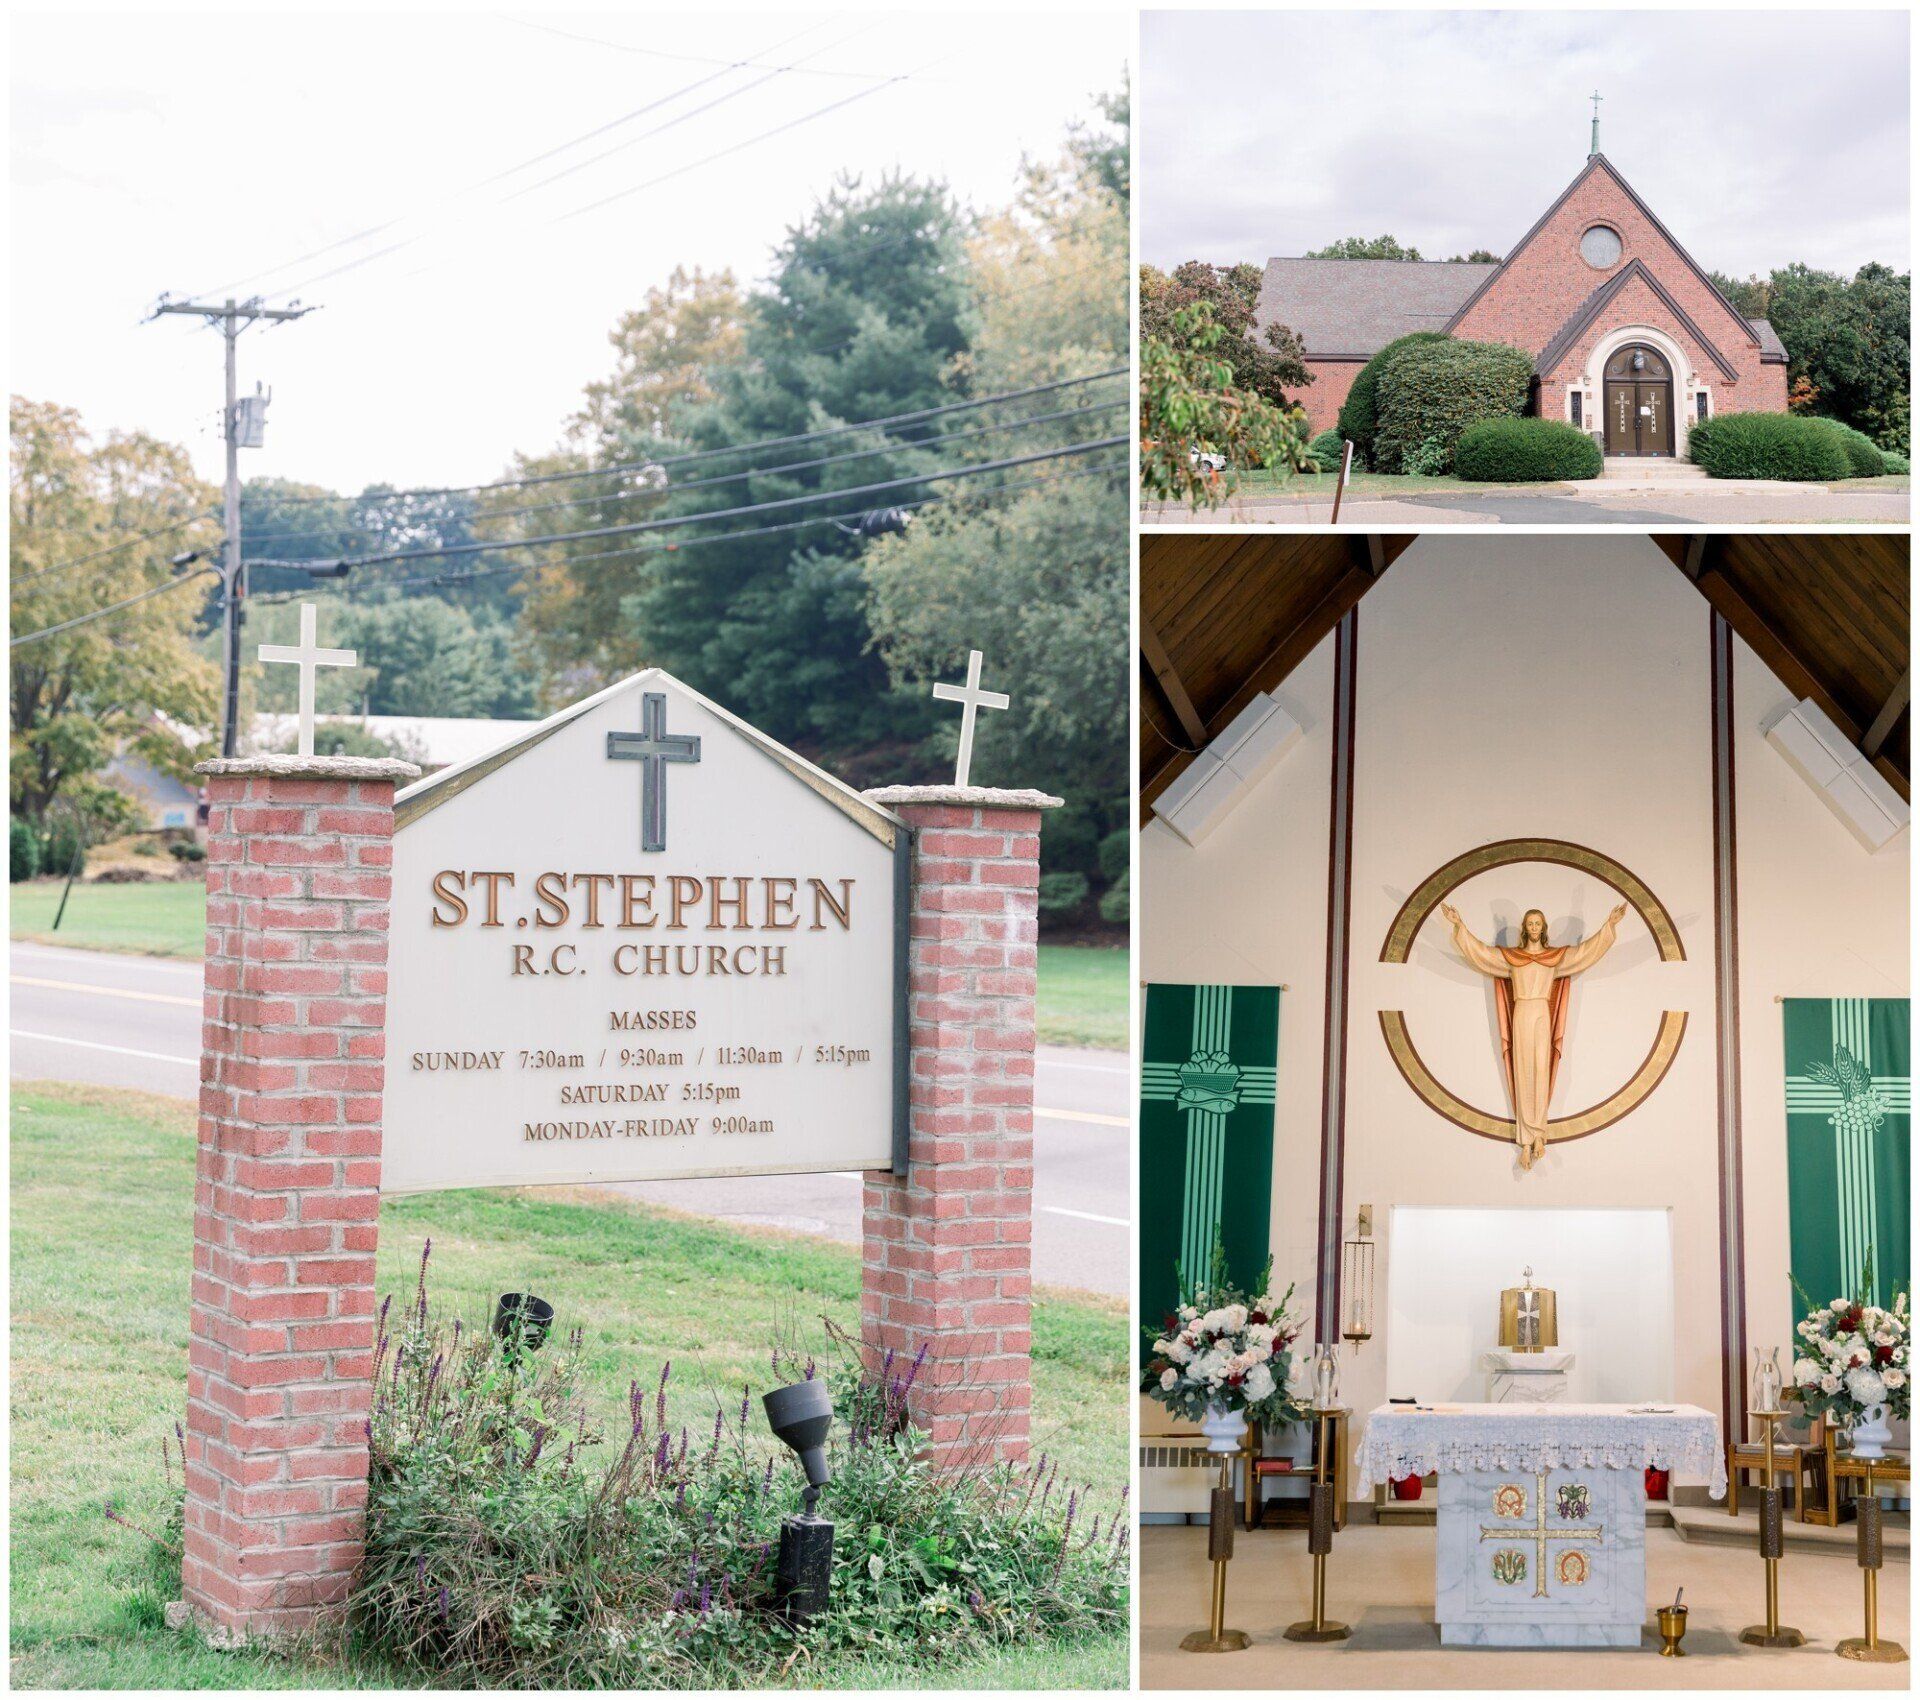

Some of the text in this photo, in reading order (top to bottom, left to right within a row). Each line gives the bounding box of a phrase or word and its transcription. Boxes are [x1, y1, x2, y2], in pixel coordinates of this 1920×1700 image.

[511, 943, 788, 977] R.C. CHURCH
[609, 1010, 697, 1031] MASSES
[412, 1050, 506, 1072] SUNDAY
[519, 1049, 585, 1070] 7:30am
[620, 1048, 684, 1068] 9:30am
[717, 1046, 783, 1066] 11:30am
[815, 1045, 871, 1065] 5:15pm
[560, 1082, 741, 1105] SATURDAY 5:15pm
[523, 1115, 775, 1142] MONDAY-FRIDAY 9:00am
